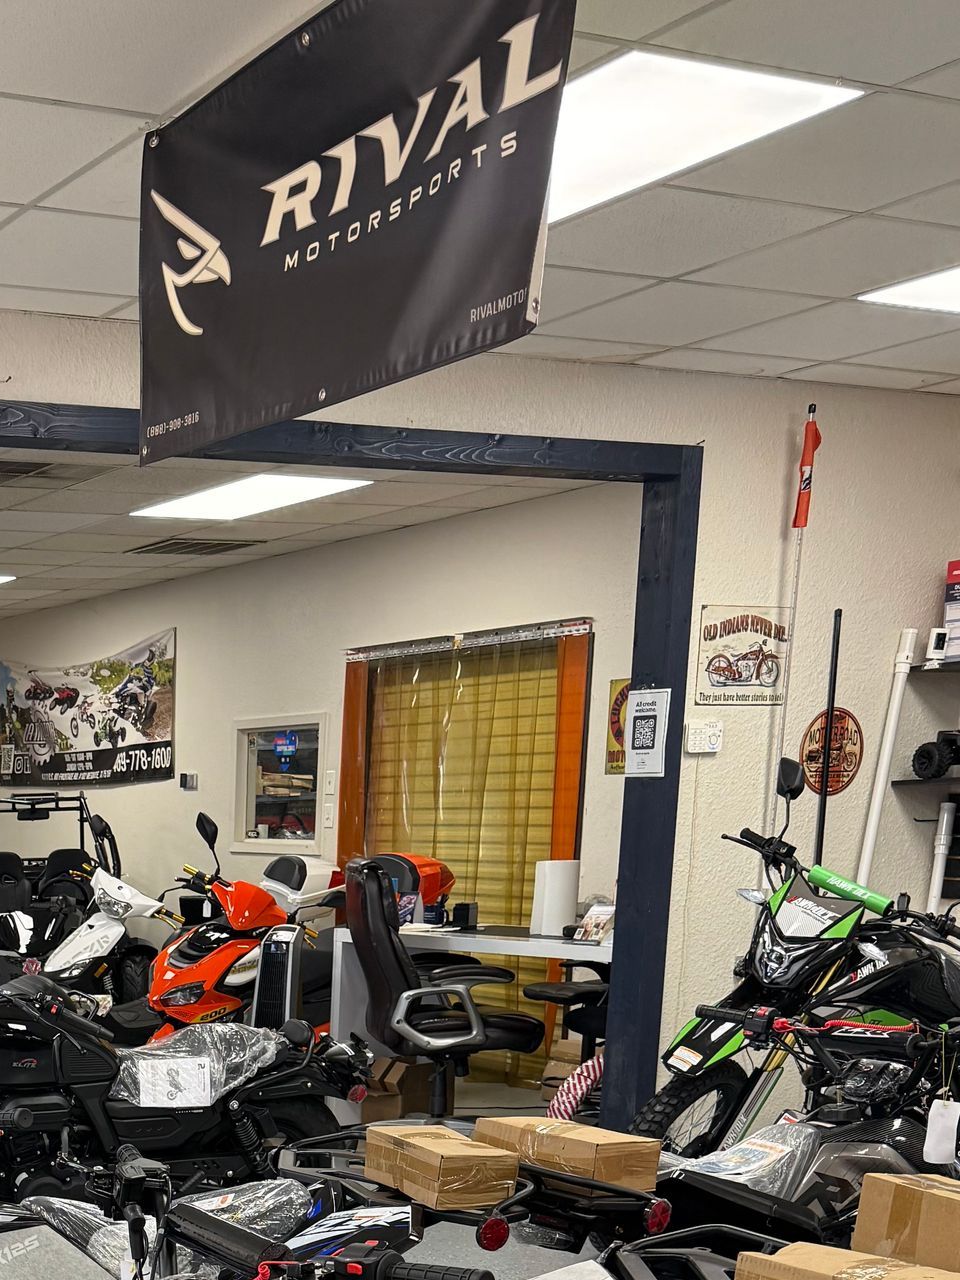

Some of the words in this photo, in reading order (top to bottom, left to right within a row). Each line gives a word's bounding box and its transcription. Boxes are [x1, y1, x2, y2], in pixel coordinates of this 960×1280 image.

[260, 14, 564, 248] RIVAL
[283, 131, 518, 272] MOTORSPORTS
[703, 624, 718, 641] OLD
[719, 614, 750, 639] INDIANS
[750, 614, 773, 639] NEVER
[699, 692, 711, 702] They
[711, 693, 722, 702] just
[723, 692, 735, 701] have
[735, 692, 750, 701] better
[751, 692, 768, 702] stories
[200, 1006, 227, 1021] 200
